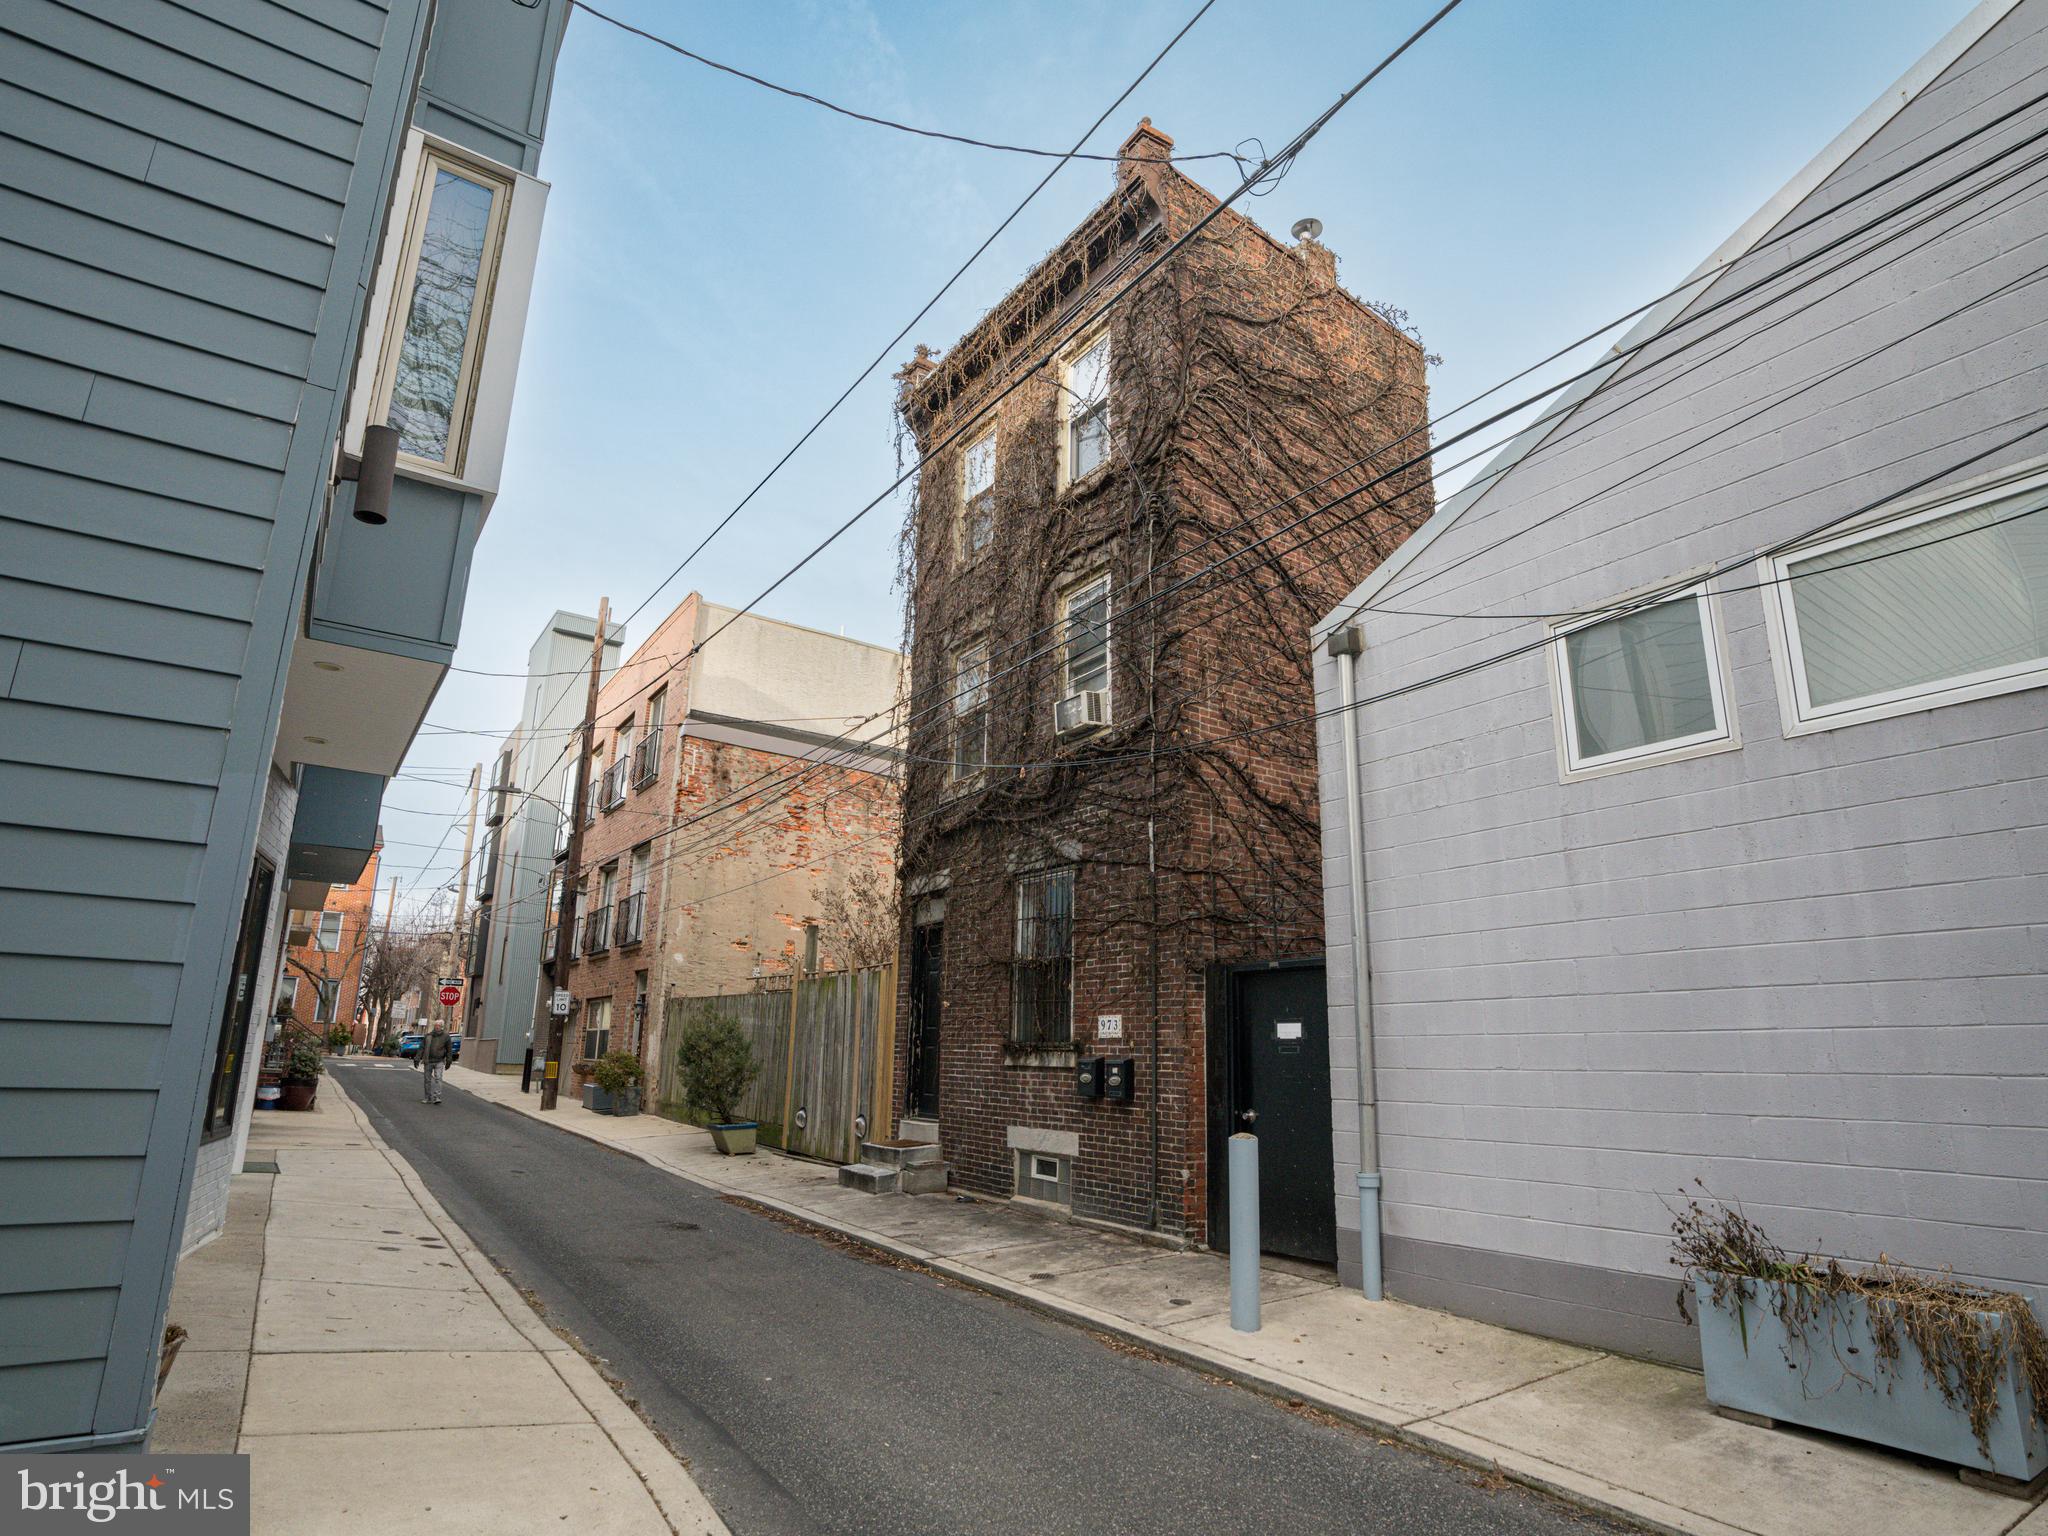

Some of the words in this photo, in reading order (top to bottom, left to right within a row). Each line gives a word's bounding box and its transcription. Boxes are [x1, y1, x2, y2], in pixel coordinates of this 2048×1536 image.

[440, 992, 460, 1000] STOP
[556, 1003, 566, 1011] 10
[1100, 1019, 1118, 1031] 973
